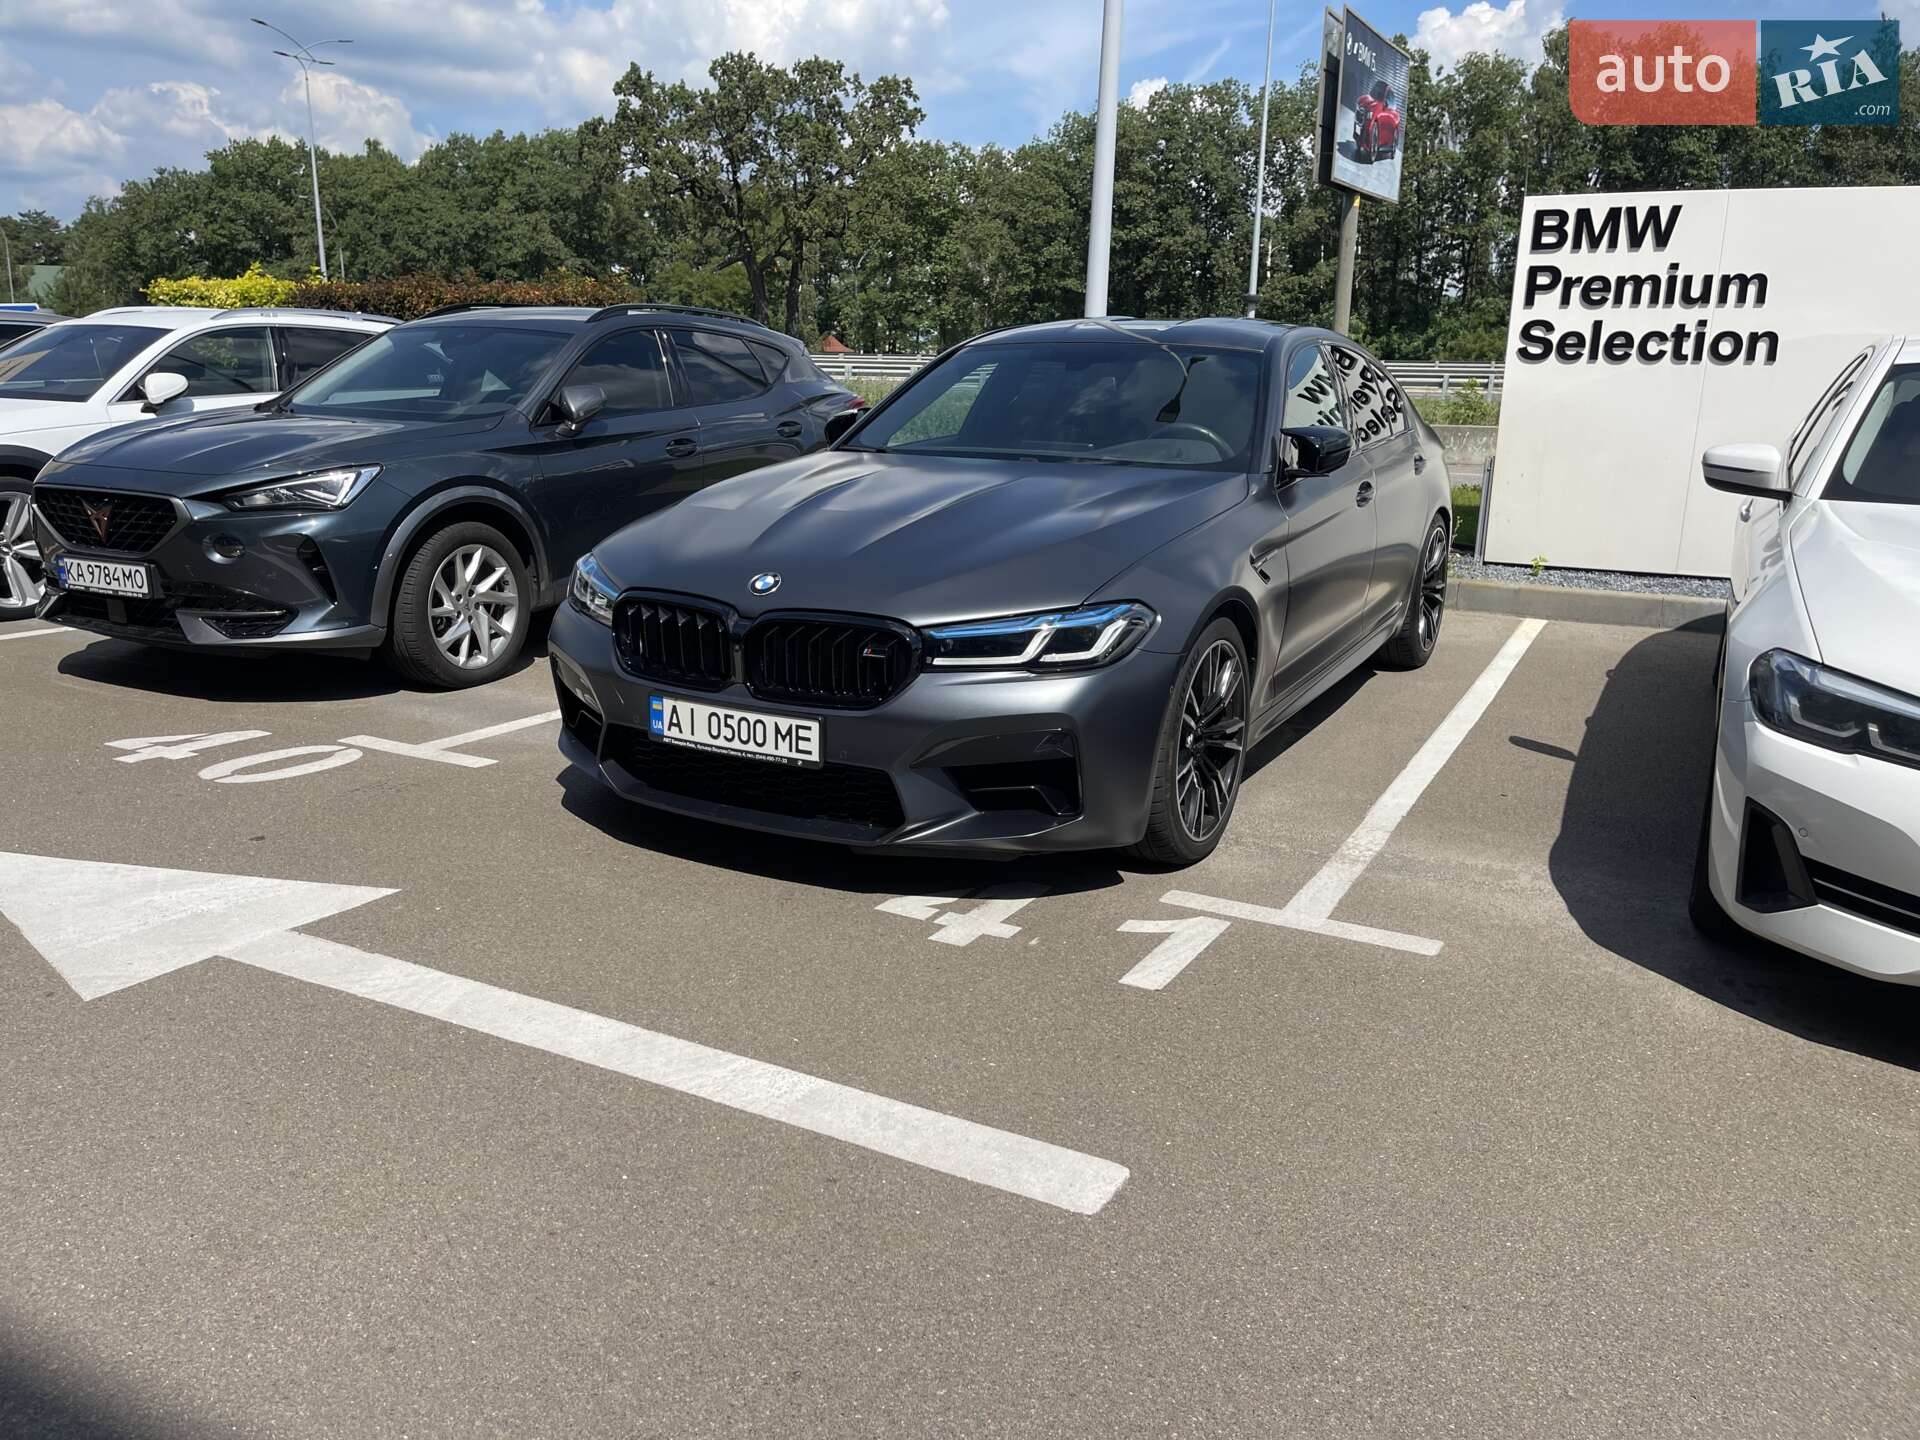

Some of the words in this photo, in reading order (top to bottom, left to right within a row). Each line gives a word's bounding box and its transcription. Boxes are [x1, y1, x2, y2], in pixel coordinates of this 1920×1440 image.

[1529, 204, 1683, 254] BMW
[1523, 262, 1768, 309] Premium
[1516, 319, 1779, 365] Selection
[707, 711, 767, 748] 0500
